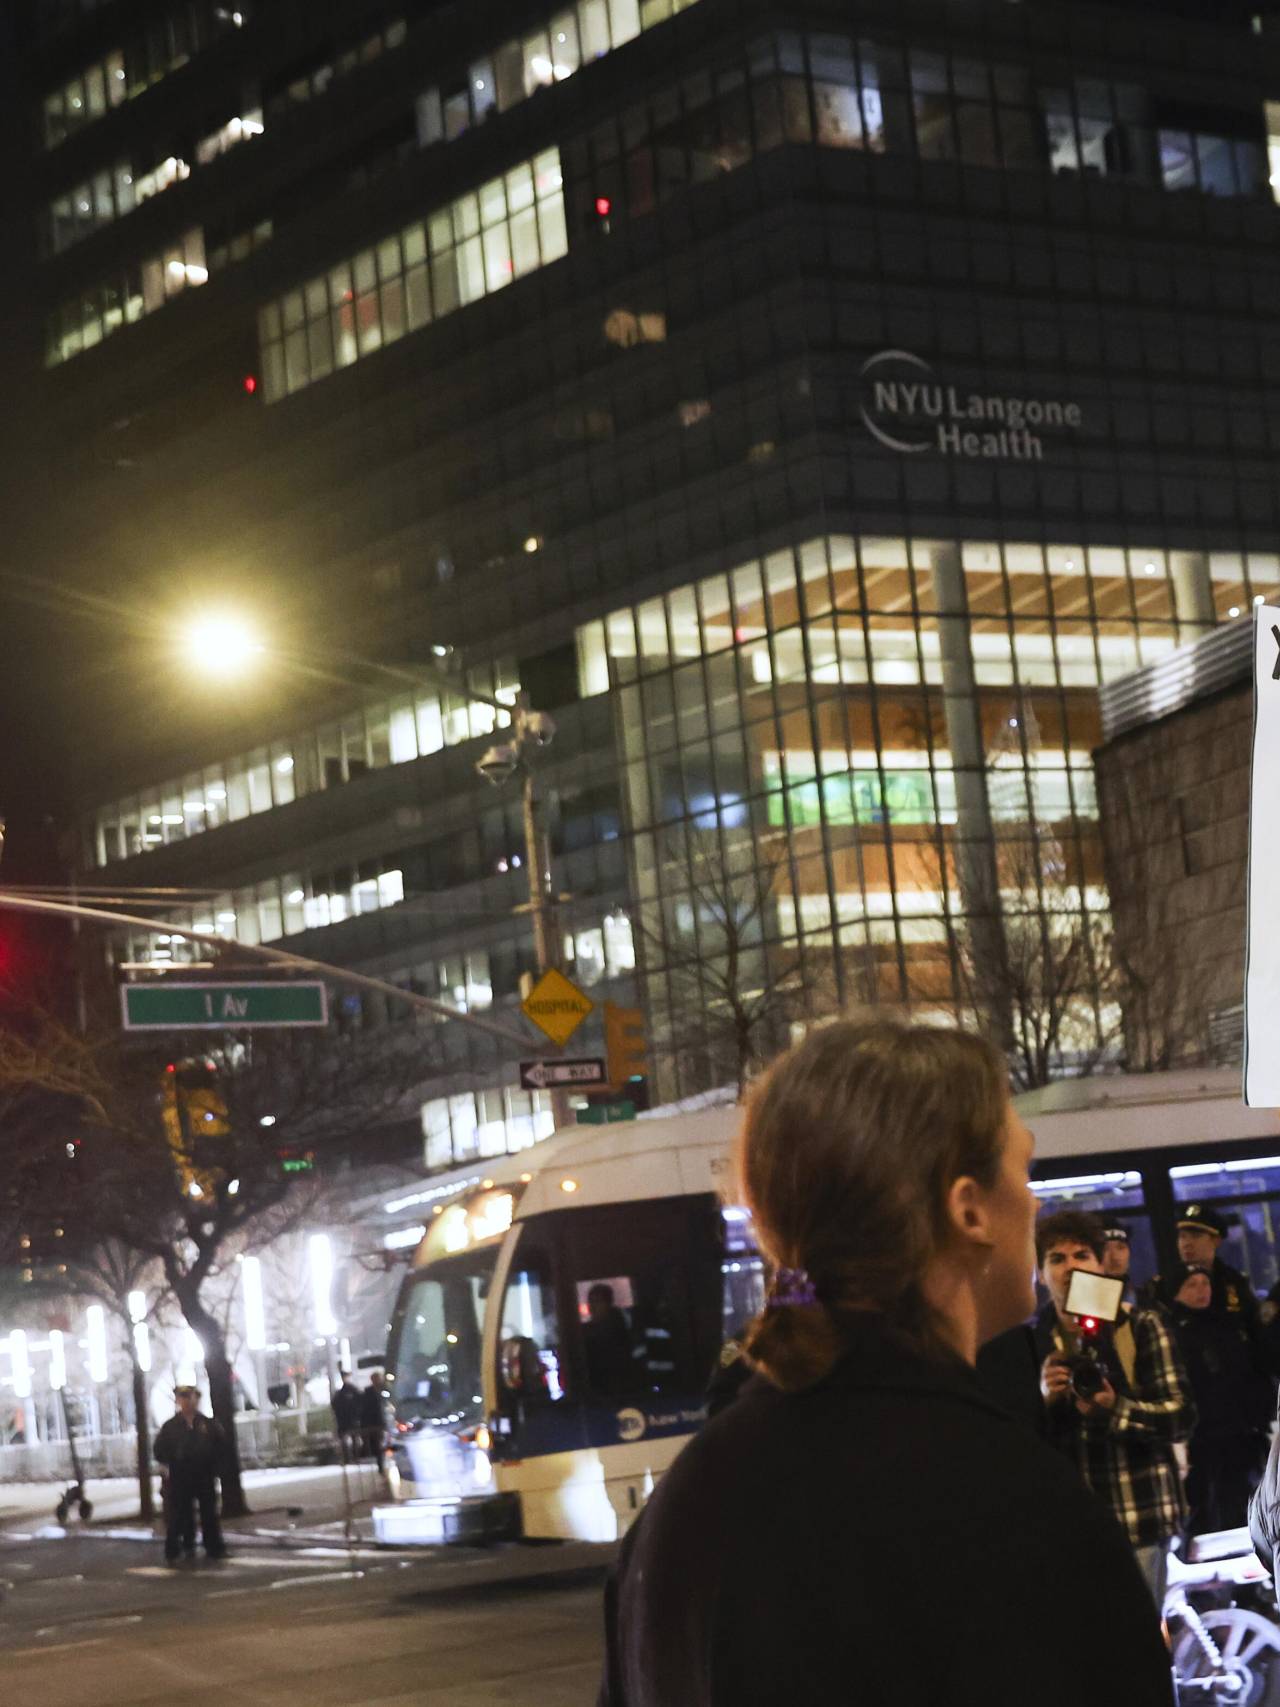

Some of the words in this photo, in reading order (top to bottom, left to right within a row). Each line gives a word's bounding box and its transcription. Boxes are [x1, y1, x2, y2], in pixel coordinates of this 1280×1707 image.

[874, 381, 943, 416] NYU
[949, 387, 1082, 430] Langone
[938, 424, 1042, 460] Health
[223, 993, 249, 1017] Av
[528, 998, 585, 1015] HOSPITAL
[534, 1065, 556, 1082] ONE
[567, 1063, 596, 1079] WAY
